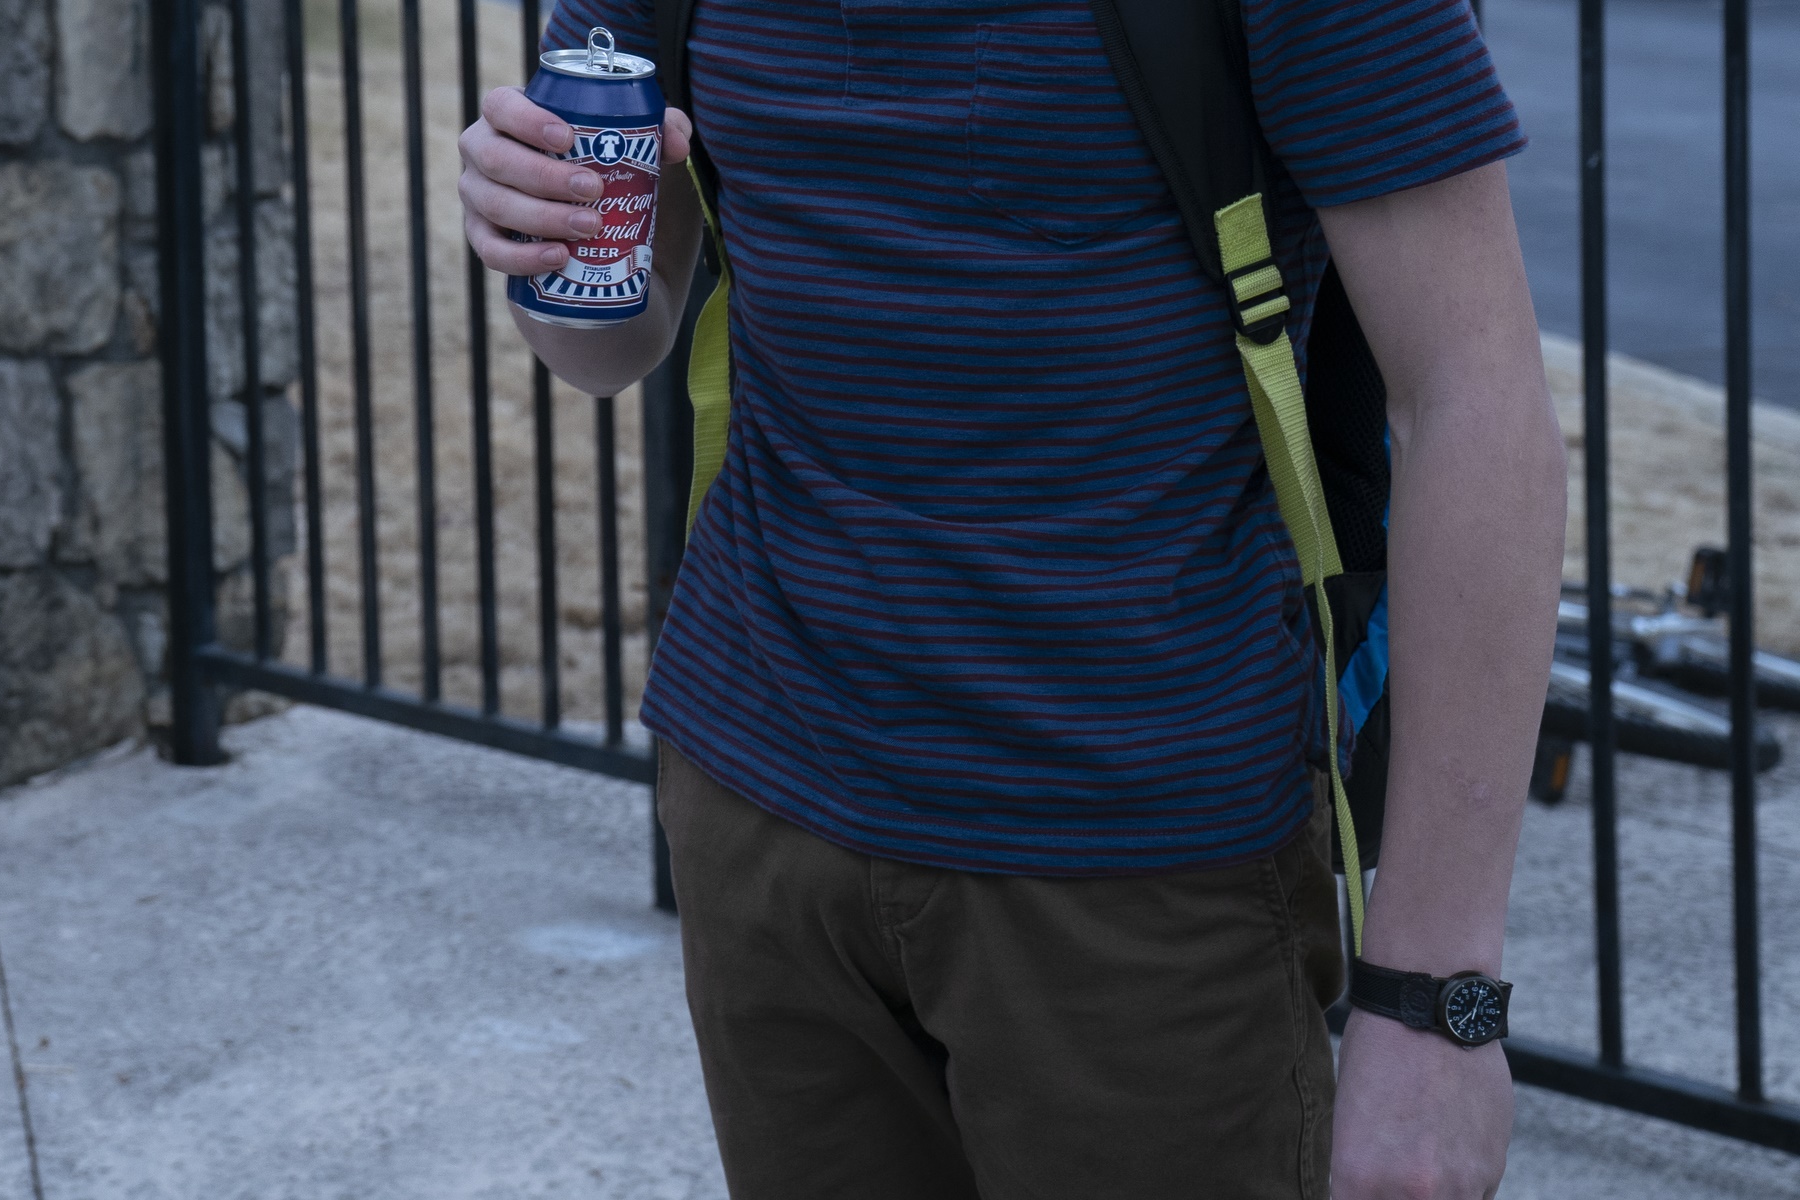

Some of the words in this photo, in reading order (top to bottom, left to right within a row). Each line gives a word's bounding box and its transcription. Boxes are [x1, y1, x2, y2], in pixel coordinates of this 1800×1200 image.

[587, 193, 653, 215] erican
[593, 214, 646, 242] onial
[577, 246, 620, 258] BEER
[581, 270, 612, 283] 1776
